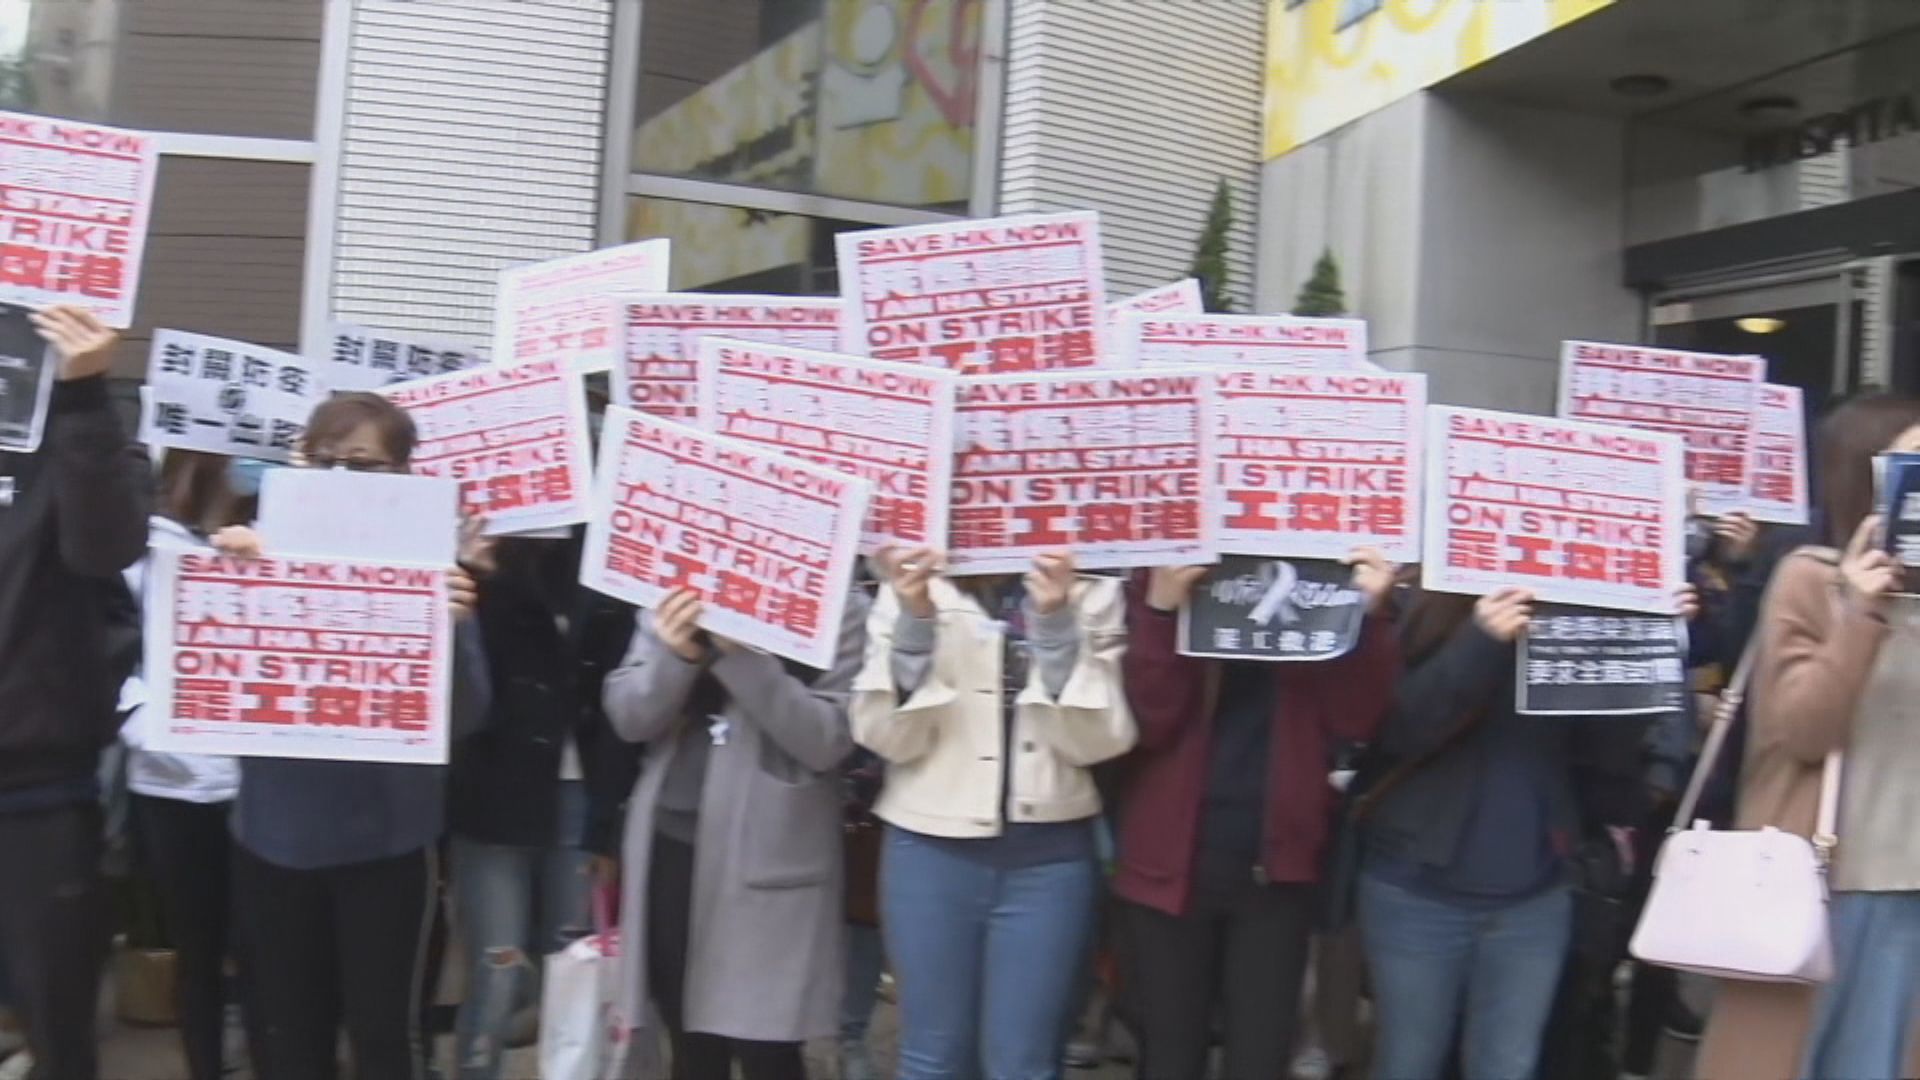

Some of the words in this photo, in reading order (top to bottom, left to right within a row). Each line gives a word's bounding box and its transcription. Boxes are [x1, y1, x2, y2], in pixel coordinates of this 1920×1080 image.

[857, 234, 943, 258] SAVE
[952, 229, 995, 246] HK
[1005, 222, 1082, 243] NOW
[626, 304, 703, 320] SAVE
[716, 306, 754, 321] HK
[764, 307, 840, 322] NOW
[867, 322, 926, 347] ON
[941, 306, 1091, 339] STRIKE
[1141, 321, 1218, 338] SAVE
[719, 348, 794, 376] SAVE
[856, 368, 932, 397] NOW
[1050, 379, 1099, 398] HK
[1110, 376, 1200, 397] NOW
[1269, 375, 1312, 393] HK
[1326, 376, 1402, 395] NOW
[628, 383, 686, 403] ON
[1450, 414, 1529, 440] SAVE
[1590, 434, 1658, 455] NOW
[627, 420, 704, 457] SAVE
[716, 450, 756, 468] HK
[767, 462, 849, 498] NOW
[1241, 463, 1406, 492] STRIKE
[951, 479, 1012, 505] ON
[1027, 472, 1199, 501] STRIKE
[1450, 502, 1504, 529] ON
[1520, 510, 1662, 548] STRIKE
[177, 554, 276, 578] SAVE
[286, 560, 336, 581] HK
[348, 564, 433, 587] NOW
[609, 508, 664, 545] ON
[678, 529, 825, 598] STRIKE
[1447, 528, 1663, 588] 罷工救港
[173, 650, 242, 677] ON
[257, 655, 430, 688] STRIKE
[171, 678, 428, 732] 罷工救港
